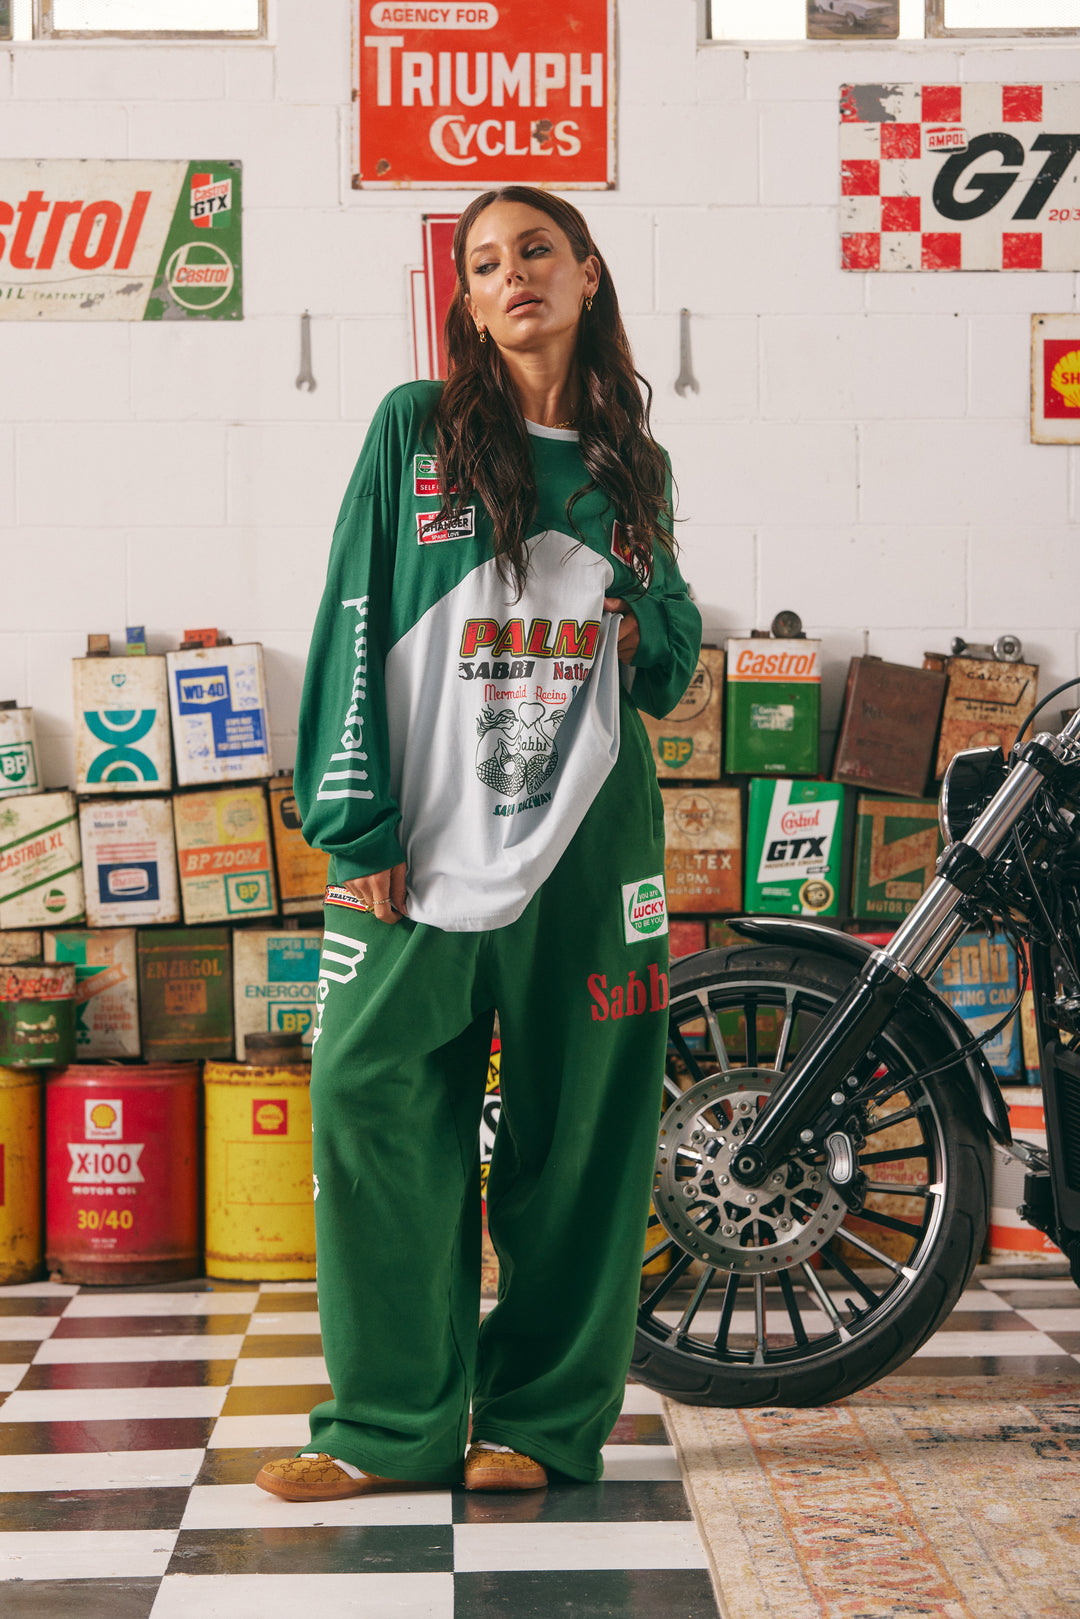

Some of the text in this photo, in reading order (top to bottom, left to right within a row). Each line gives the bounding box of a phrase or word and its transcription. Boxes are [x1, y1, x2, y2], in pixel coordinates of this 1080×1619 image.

[381, 9, 488, 23] AGENCY FOR
[364, 36, 603, 108] TRIUMPH
[429, 114, 582, 166] CYCLES
[928, 133, 965, 147] AMPOL
[193, 182, 229, 202] Castrol
[194, 195, 228, 217] GTX
[175, 267, 229, 284] Castrol
[459, 617, 601, 660] PALM
[458, 660, 535, 680] SABBI
[736, 649, 816, 675] Castrol
[182, 682, 224, 700] WD-40
[484, 684, 527, 702] Mermaid
[534, 685, 568, 705] Racing
[663, 741, 691, 761] BP
[2, 754, 27, 776] BP
[780, 808, 821, 836] Castrol
[0, 839, 48, 873] CASTROL
[48, 832, 64, 851] XL
[766, 836, 828, 862] GTX
[185, 847, 263, 872] BP ZOOM
[676, 873, 710, 885] RPM
[238, 883, 259, 899] BP
[639, 893, 649, 902] you
[634, 900, 664, 919] LUCKY
[866, 900, 903, 913] MOTOR
[635, 915, 664, 930] TO BE YOU
[147, 958, 223, 979] ENERGOL
[6, 975, 65, 995] Castrol
[989, 988, 1016, 1005] CAN
[282, 1013, 310, 1032] BP
[72, 1186, 137, 1196] MOTOR OIL
[77, 1208, 134, 1231] 30/40
